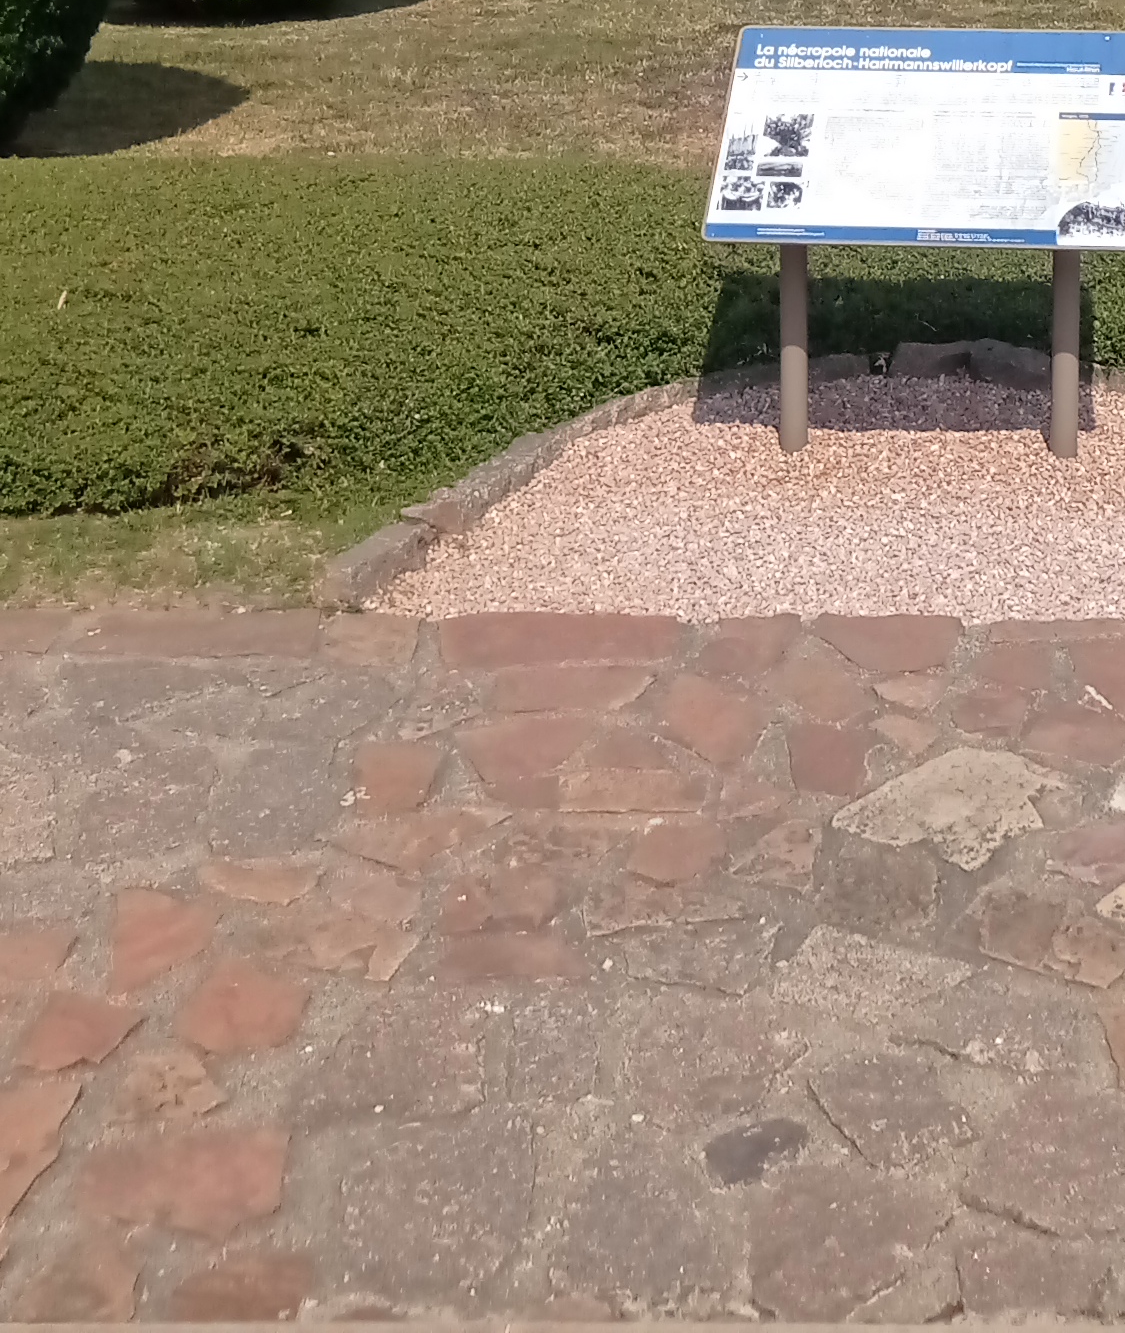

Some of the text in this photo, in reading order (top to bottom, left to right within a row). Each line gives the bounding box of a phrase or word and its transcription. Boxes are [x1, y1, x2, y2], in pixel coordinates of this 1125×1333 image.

[756, 43, 932, 58] La nécropole nationale
[754, 57, 774, 68] du
[777, 57, 1014, 72] Silberloch-Hartmannswillerkopf
